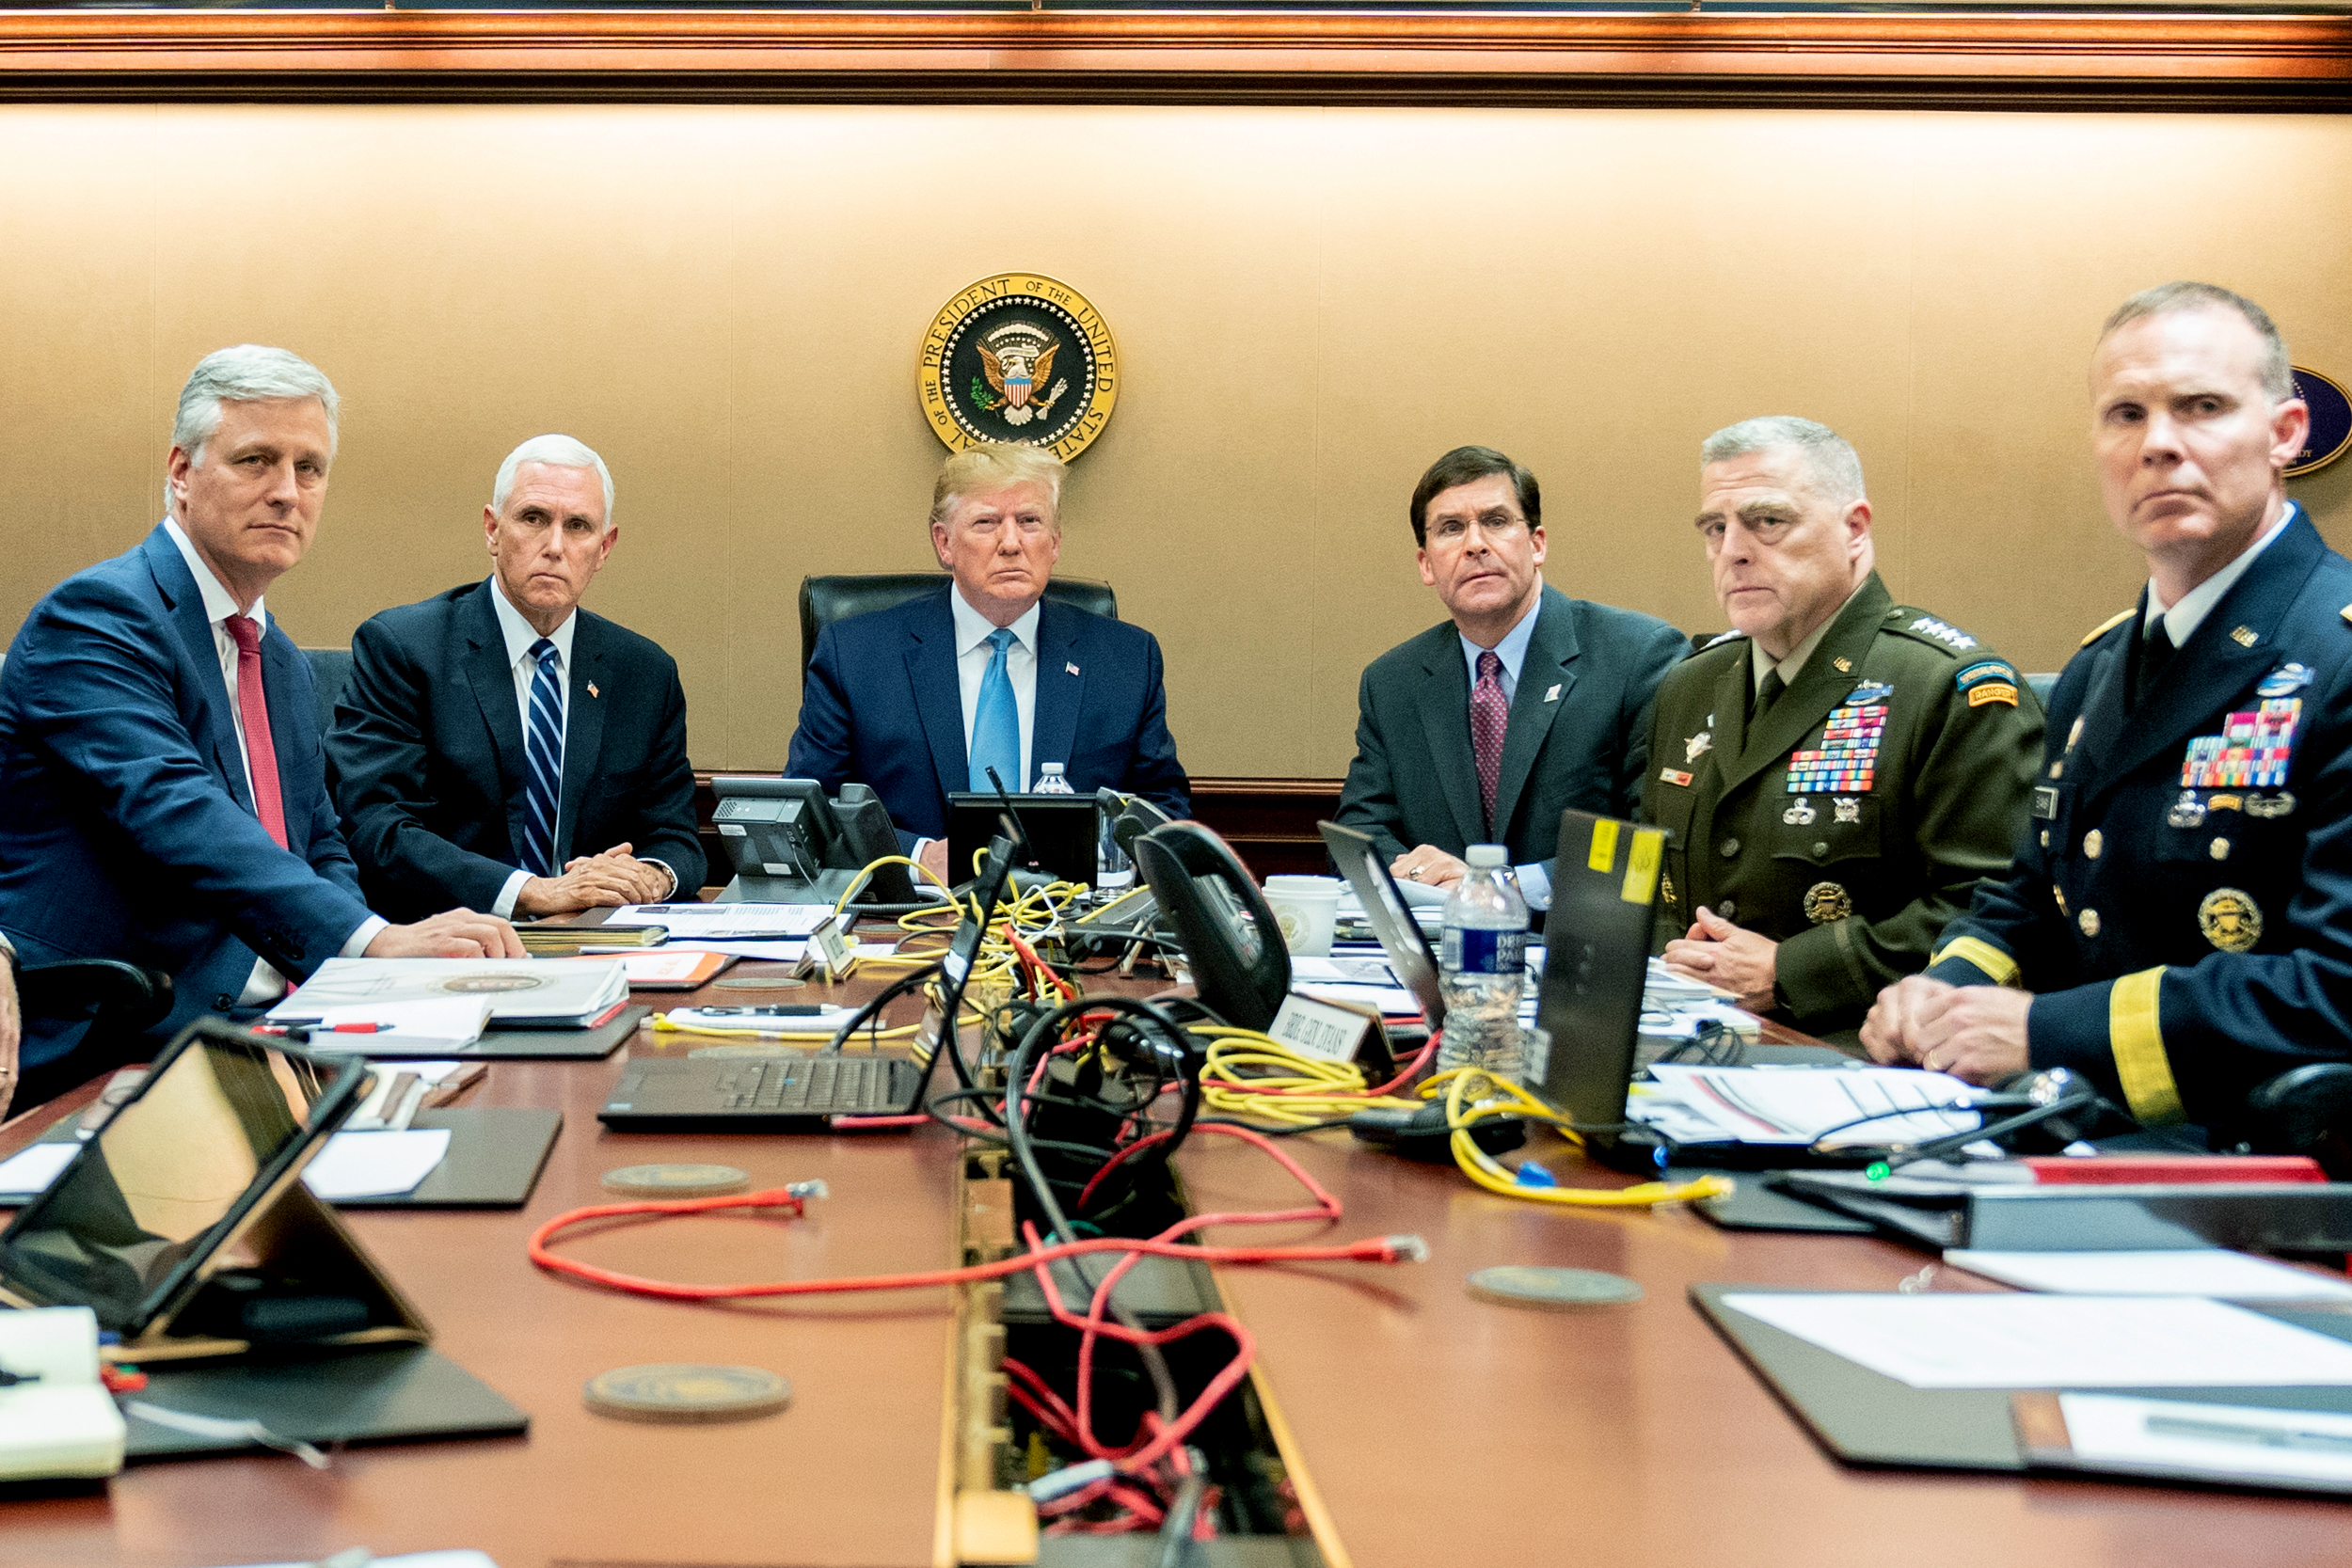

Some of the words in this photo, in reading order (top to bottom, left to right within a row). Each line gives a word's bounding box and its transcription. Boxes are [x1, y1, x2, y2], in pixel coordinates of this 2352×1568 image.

[1025, 280, 1043, 293] OF
[1048, 286, 1072, 306] THE
[923, 278, 1010, 368] PRESIDENT
[1077, 307, 1114, 393] UNITED
[925, 379, 939, 404] THE
[934, 410, 948, 426] OF
[1048, 406, 1104, 460] STATE
